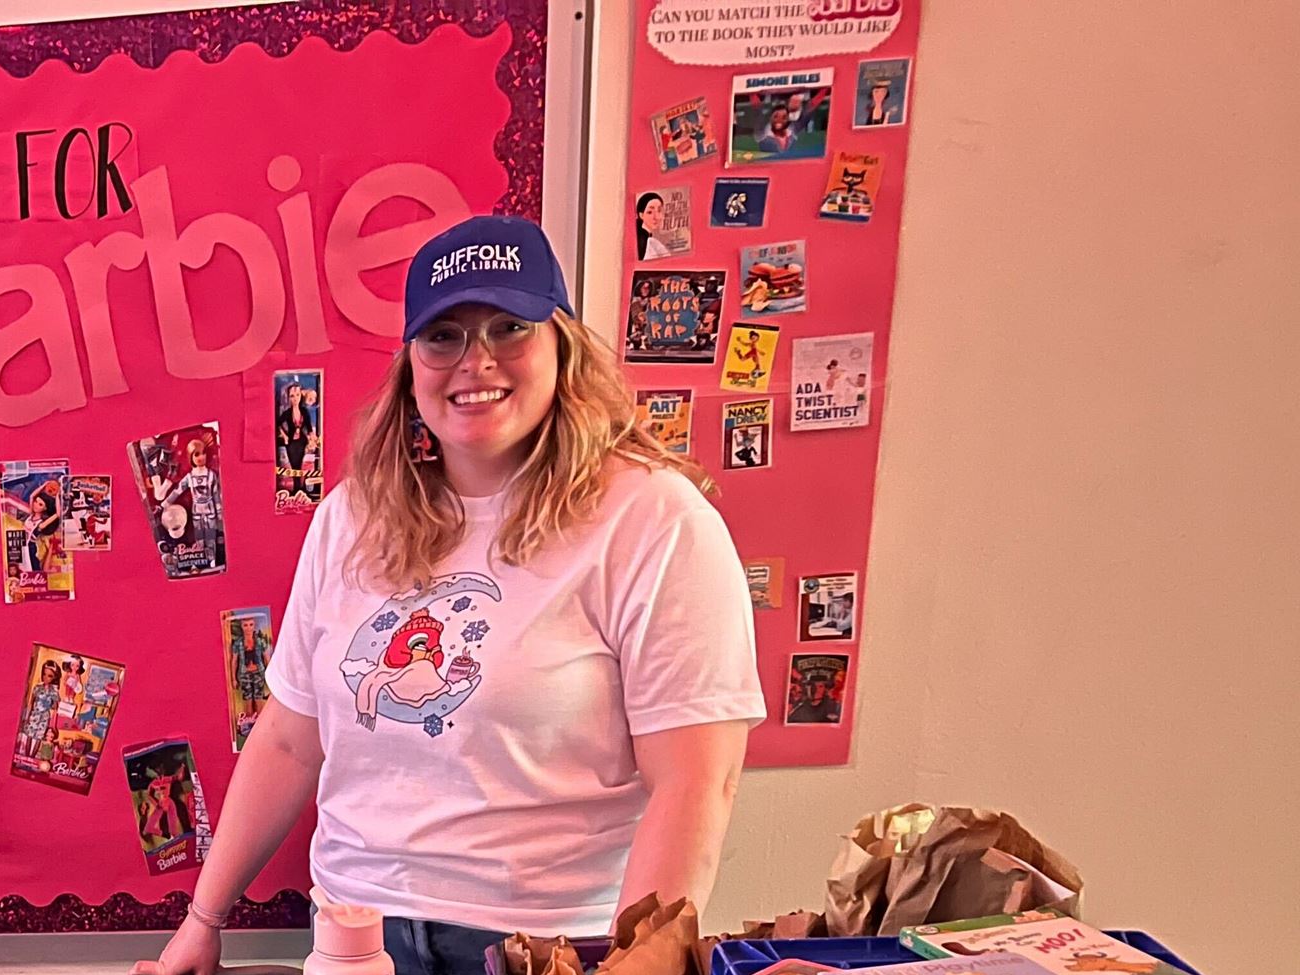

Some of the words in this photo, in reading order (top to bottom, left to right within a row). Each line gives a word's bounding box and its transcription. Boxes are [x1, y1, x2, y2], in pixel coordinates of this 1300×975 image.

[685, 9, 714, 23] YOU
[718, 6, 770, 21] MATCH
[773, 4, 807, 18] THE
[654, 31, 676, 44] TO
[678, 29, 709, 43] THE
[712, 27, 753, 41] BOOK
[757, 24, 796, 39] THEY
[799, 22, 853, 36] WOULD
[857, 19, 893, 33] LIKE
[745, 44, 795, 59] MOST?
[746, 75, 789, 88] SIMONE
[15, 121, 136, 221] FOR
[432, 244, 521, 277] SUFFOLK
[430, 262, 467, 287] PUBLIC
[472, 260, 521, 273] LIBRARY
[660, 278, 693, 293] THE
[650, 295, 699, 312] ROOTS
[665, 312, 681, 323] OF
[651, 324, 687, 340] RAP
[796, 382, 822, 395] ADA
[649, 399, 681, 414] ART
[728, 405, 766, 417] NANCY
[795, 405, 859, 421] SCIENTIST
[735, 414, 769, 426] DREW
[276, 489, 312, 509] Barbie
[20, 572, 47, 587] Barbie
[53, 762, 89, 779] Barbie
[157, 852, 188, 871] Barbie
[1034, 928, 1084, 954] MOO!
[923, 953, 1026, 974] Playtime
